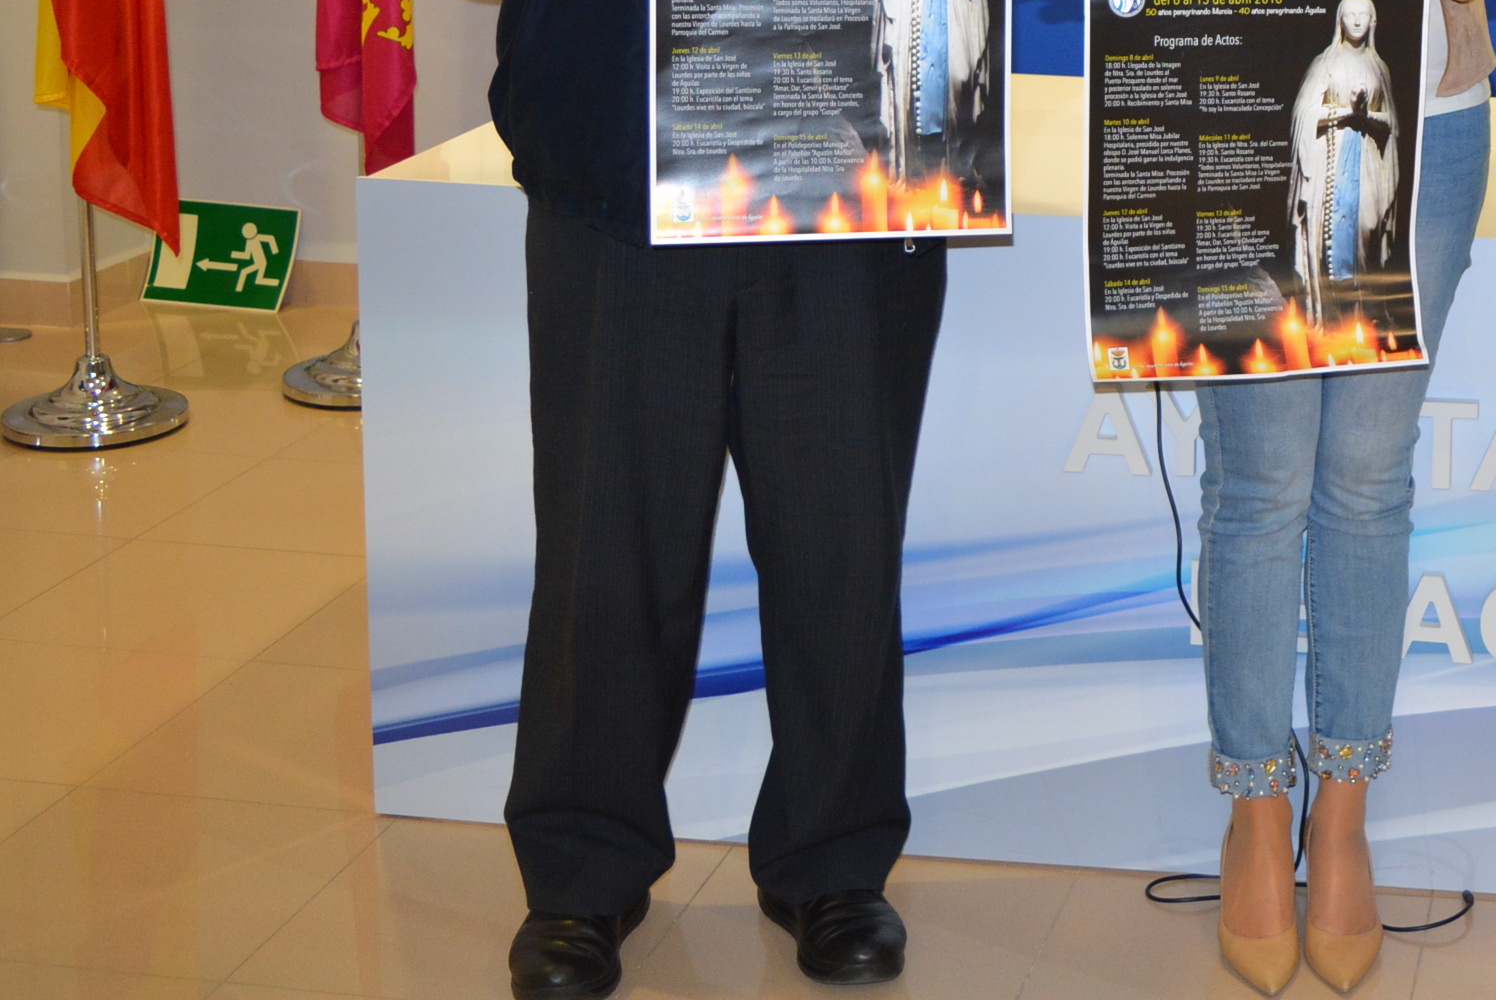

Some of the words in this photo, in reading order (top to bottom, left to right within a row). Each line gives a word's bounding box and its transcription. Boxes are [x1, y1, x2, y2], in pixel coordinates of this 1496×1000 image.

[1173, 8, 1210, 17] peregrinando
[1266, 7, 1303, 15] peregrinando
[1154, 35, 1198, 49] Programa
[1201, 34, 1213, 45] de
[1215, 34, 1242, 45] Actos:
